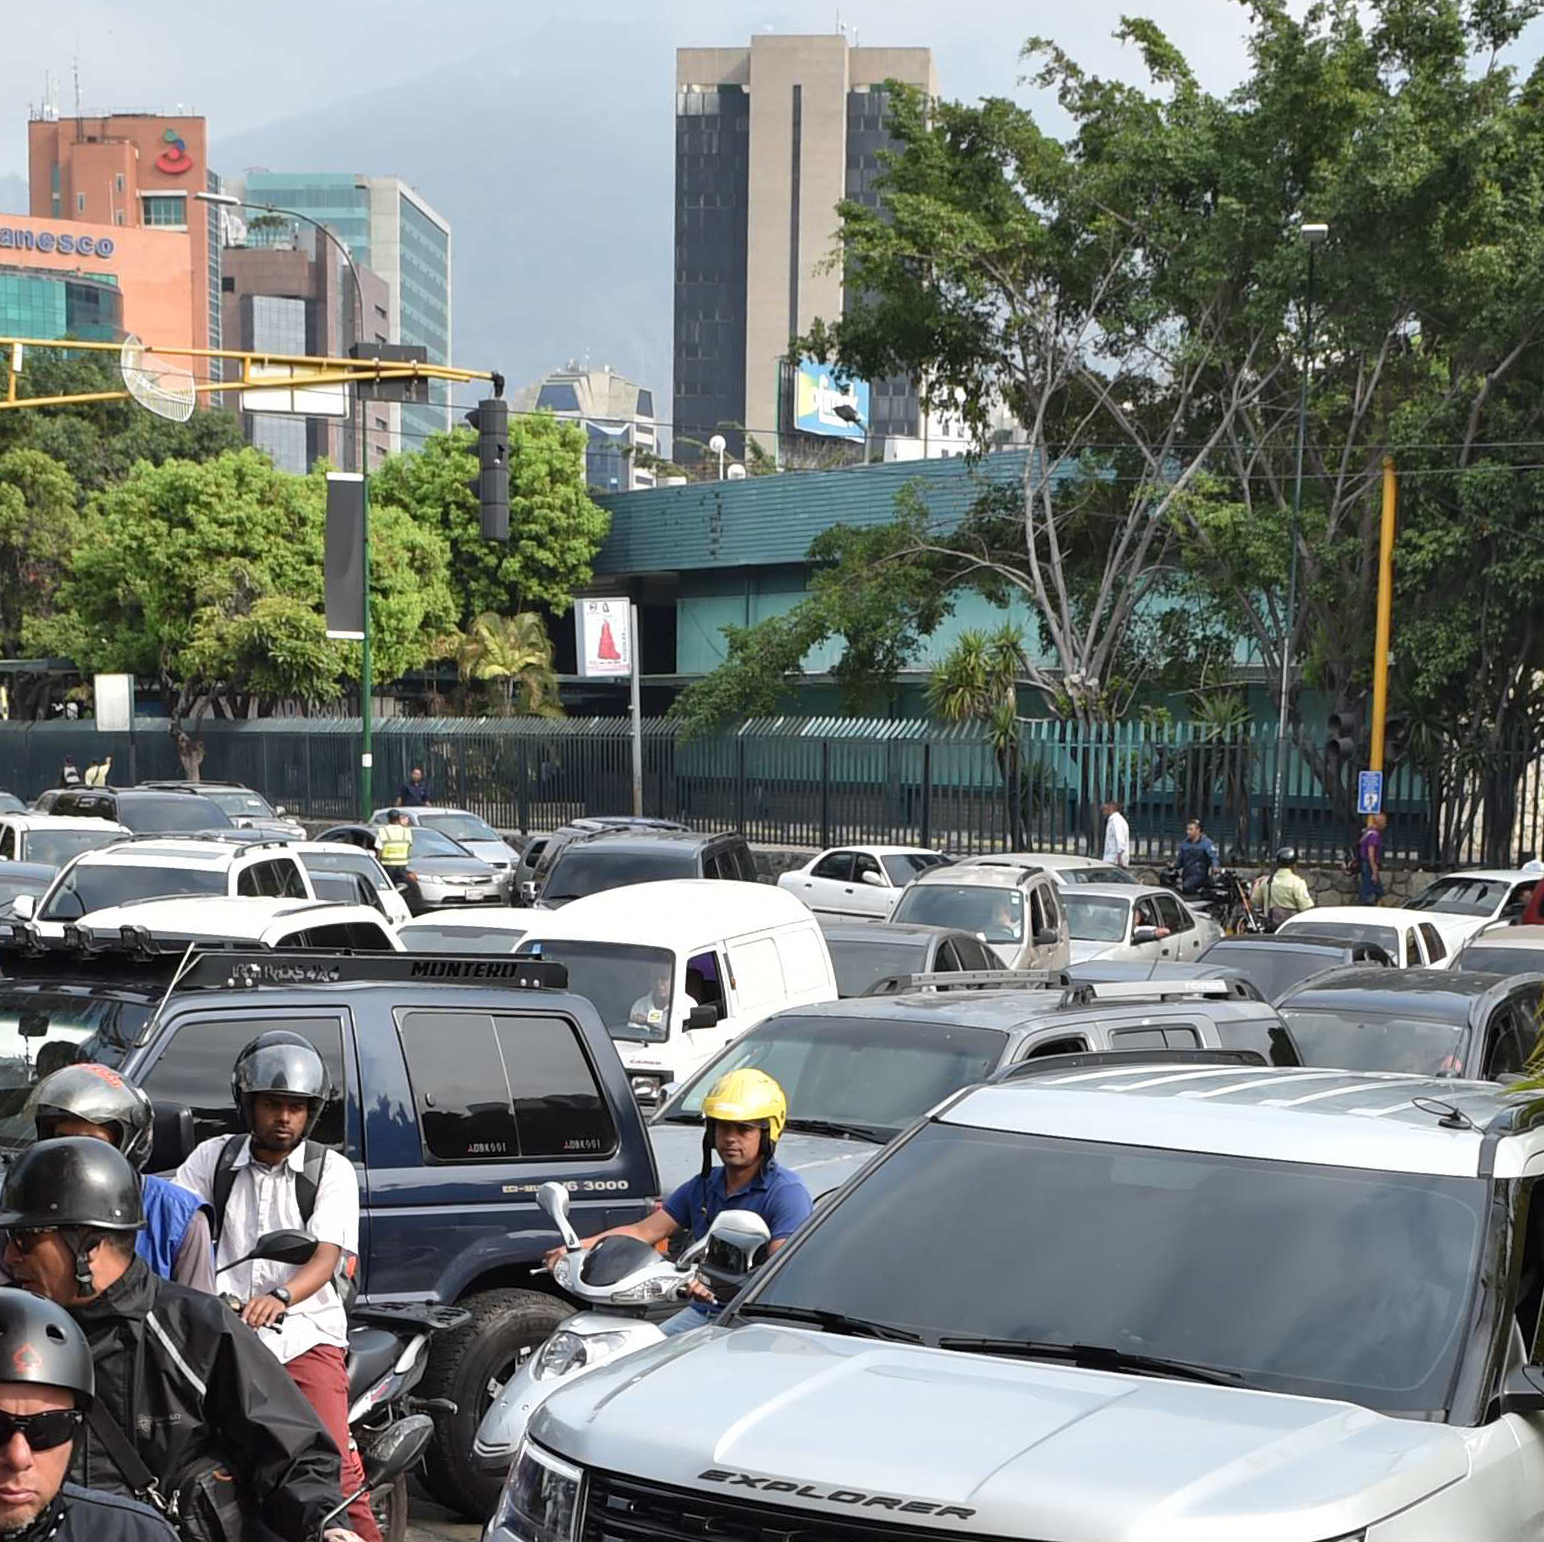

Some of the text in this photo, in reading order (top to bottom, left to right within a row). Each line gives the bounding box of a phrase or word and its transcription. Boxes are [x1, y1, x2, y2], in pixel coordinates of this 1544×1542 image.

[411, 961, 517, 979] MONTERO
[584, 1180, 629, 1191] 3000
[697, 1468, 977, 1520] EXPLORER
